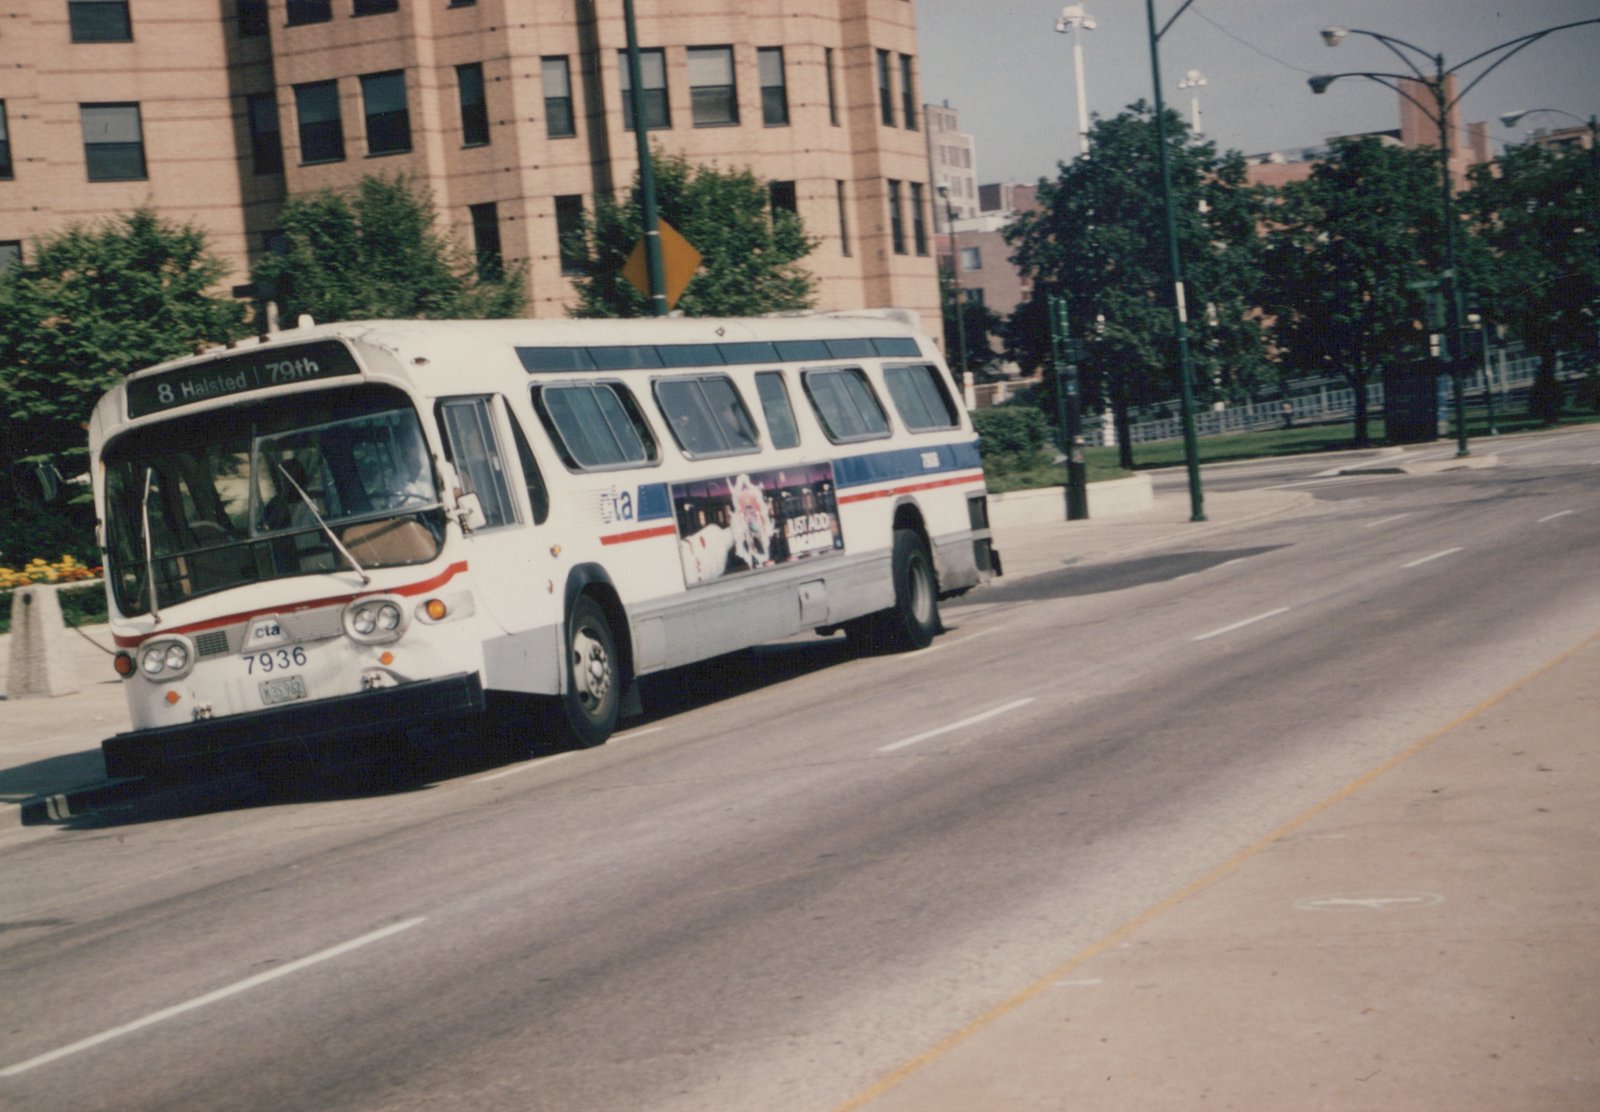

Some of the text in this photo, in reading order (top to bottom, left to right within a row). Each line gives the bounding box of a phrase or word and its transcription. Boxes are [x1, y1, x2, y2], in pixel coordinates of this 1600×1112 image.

[157, 357, 320, 404] 8 Halsted 79th
[807, 511, 831, 531] ADD
[256, 625, 280, 638] cta
[243, 647, 307, 675] 7936
